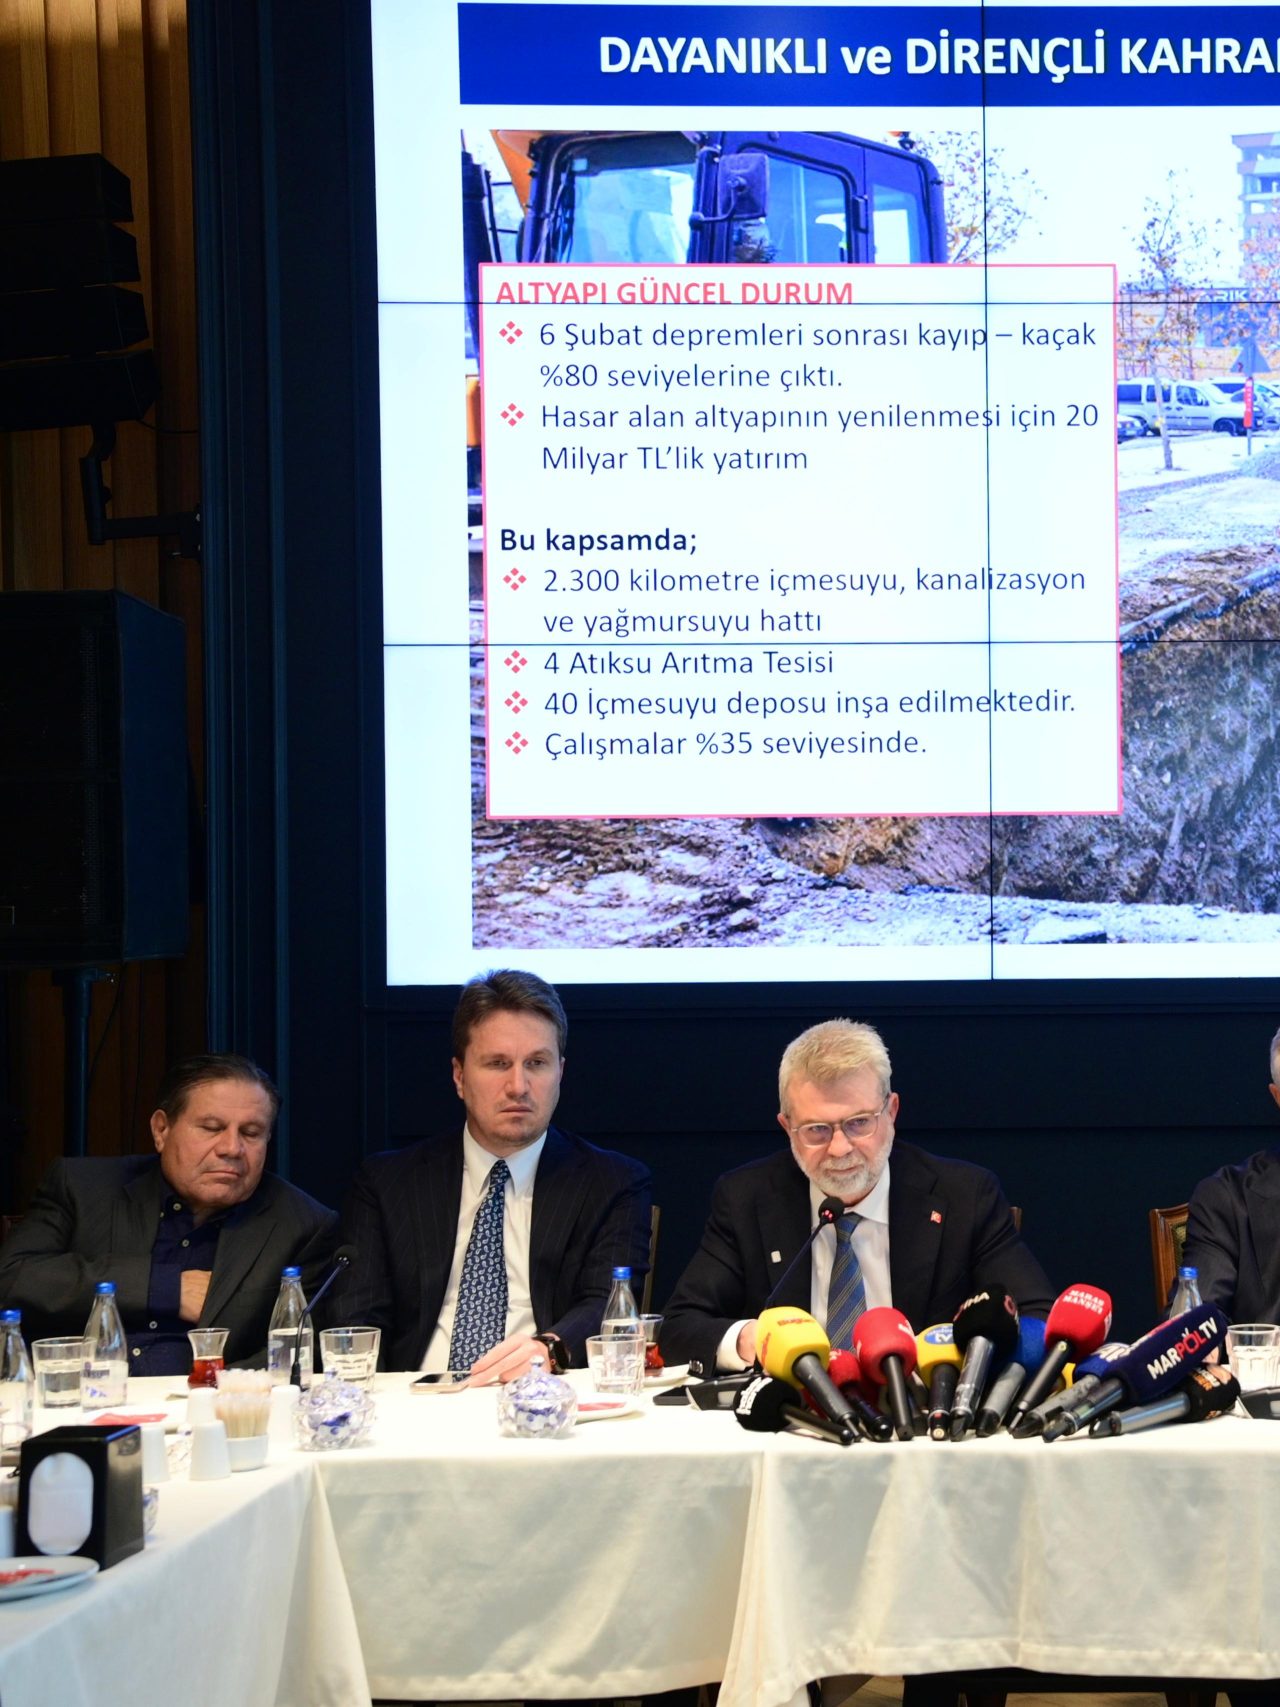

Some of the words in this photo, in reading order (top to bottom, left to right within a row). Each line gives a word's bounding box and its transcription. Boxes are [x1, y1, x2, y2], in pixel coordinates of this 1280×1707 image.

[601, 37, 826, 73] DAYANIKLI
[841, 46, 891, 74] ve
[906, 28, 1105, 83] DİRENÇLİ
[497, 282, 606, 304] ALTYAPI
[617, 277, 730, 304] GÜNCEL
[742, 282, 852, 304] DURUM
[540, 323, 555, 345] 6
[565, 322, 642, 351] Şubat
[653, 323, 802, 351] depremleri
[814, 329, 906, 345] sonrası
[919, 322, 987, 351] kayıp
[1023, 322, 1095, 351] kaçak
[541, 364, 597, 387] %80
[608, 364, 769, 392] seviyelerine
[781, 364, 841, 392] çıktı.
[543, 405, 619, 427] Hasar
[629, 405, 683, 427] alan
[696, 405, 827, 433] altyapının
[838, 404, 999, 432] yenilenmesi
[1012, 404, 1055, 432] için
[1067, 404, 1098, 426] 20
[544, 446, 628, 473] Milyar
[714, 449, 806, 473] yatırım
[501, 529, 534, 550] Bu
[547, 528, 696, 556] kapsamda;
[545, 570, 619, 591] 2.300
[631, 569, 759, 591] kilometre
[771, 569, 904, 596] içmesuyu,
[917, 567, 1084, 595] kanalizasyon
[544, 616, 573, 632] ve
[584, 608, 748, 637] yağmursuyu
[761, 609, 820, 631] hattı
[544, 652, 559, 674] 4
[570, 651, 650, 674] Atıksu
[662, 652, 752, 673] Arıtma
[763, 651, 832, 673] Tesisi
[545, 693, 577, 714] 40
[589, 688, 716, 720] İçmesuyu
[728, 691, 825, 719] deposu
[838, 691, 888, 718] inşa
[900, 689, 1074, 712] edilmektedir.
[546, 732, 686, 760] Çalışmalar
[696, 732, 752, 755] %35
[763, 730, 925, 759] seviyesinde.
